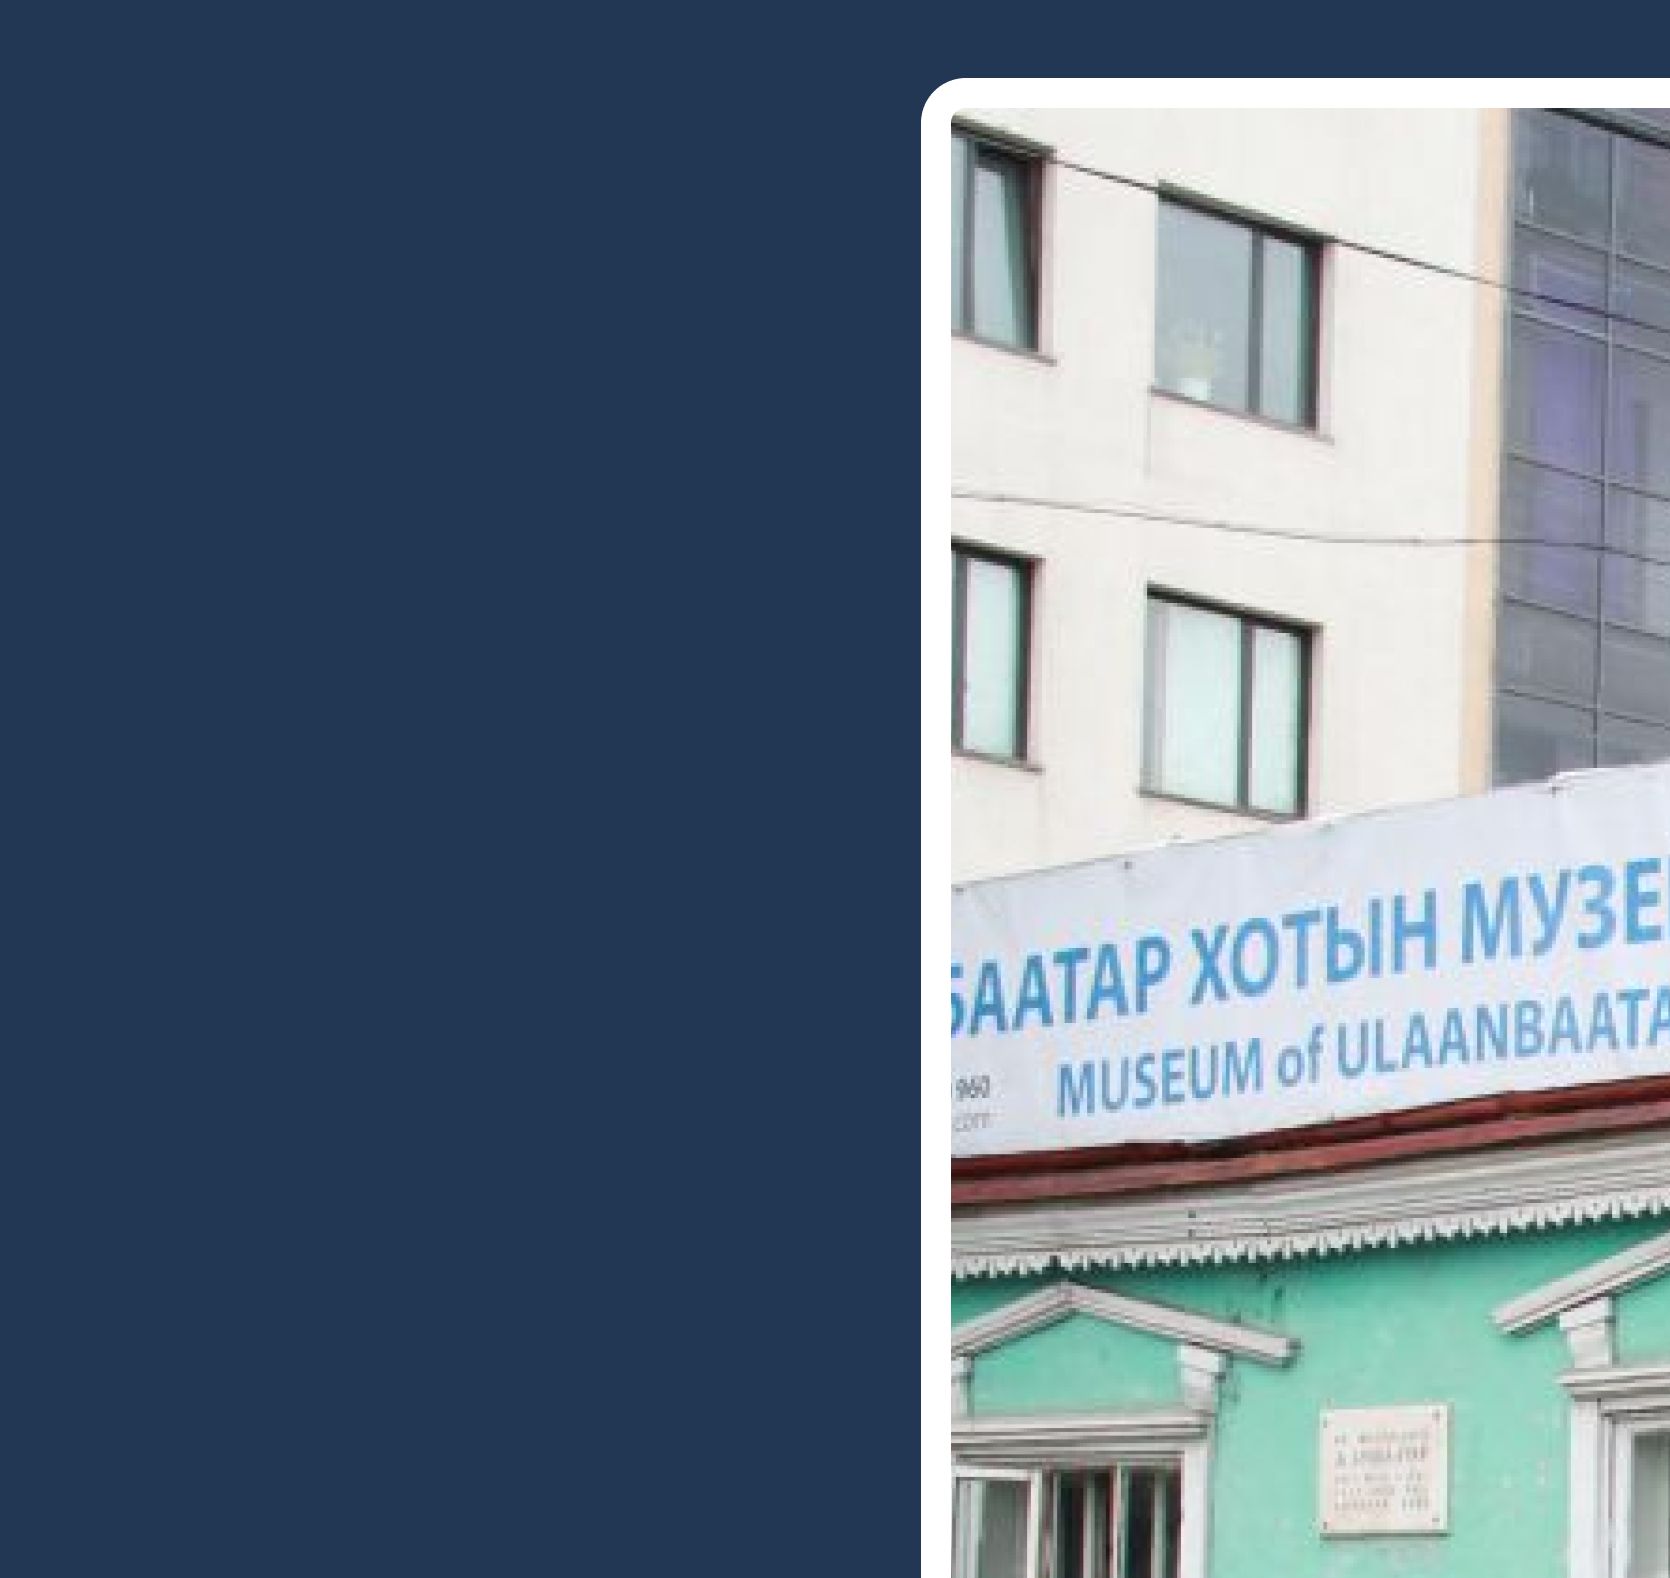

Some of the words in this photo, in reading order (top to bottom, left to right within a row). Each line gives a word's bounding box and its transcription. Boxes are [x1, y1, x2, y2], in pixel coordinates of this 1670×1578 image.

[1189, 888, 1437, 1005] ХОТЫН
[1057, 1037, 1263, 1119] MUSEUM
[1277, 1023, 1325, 1088] of
